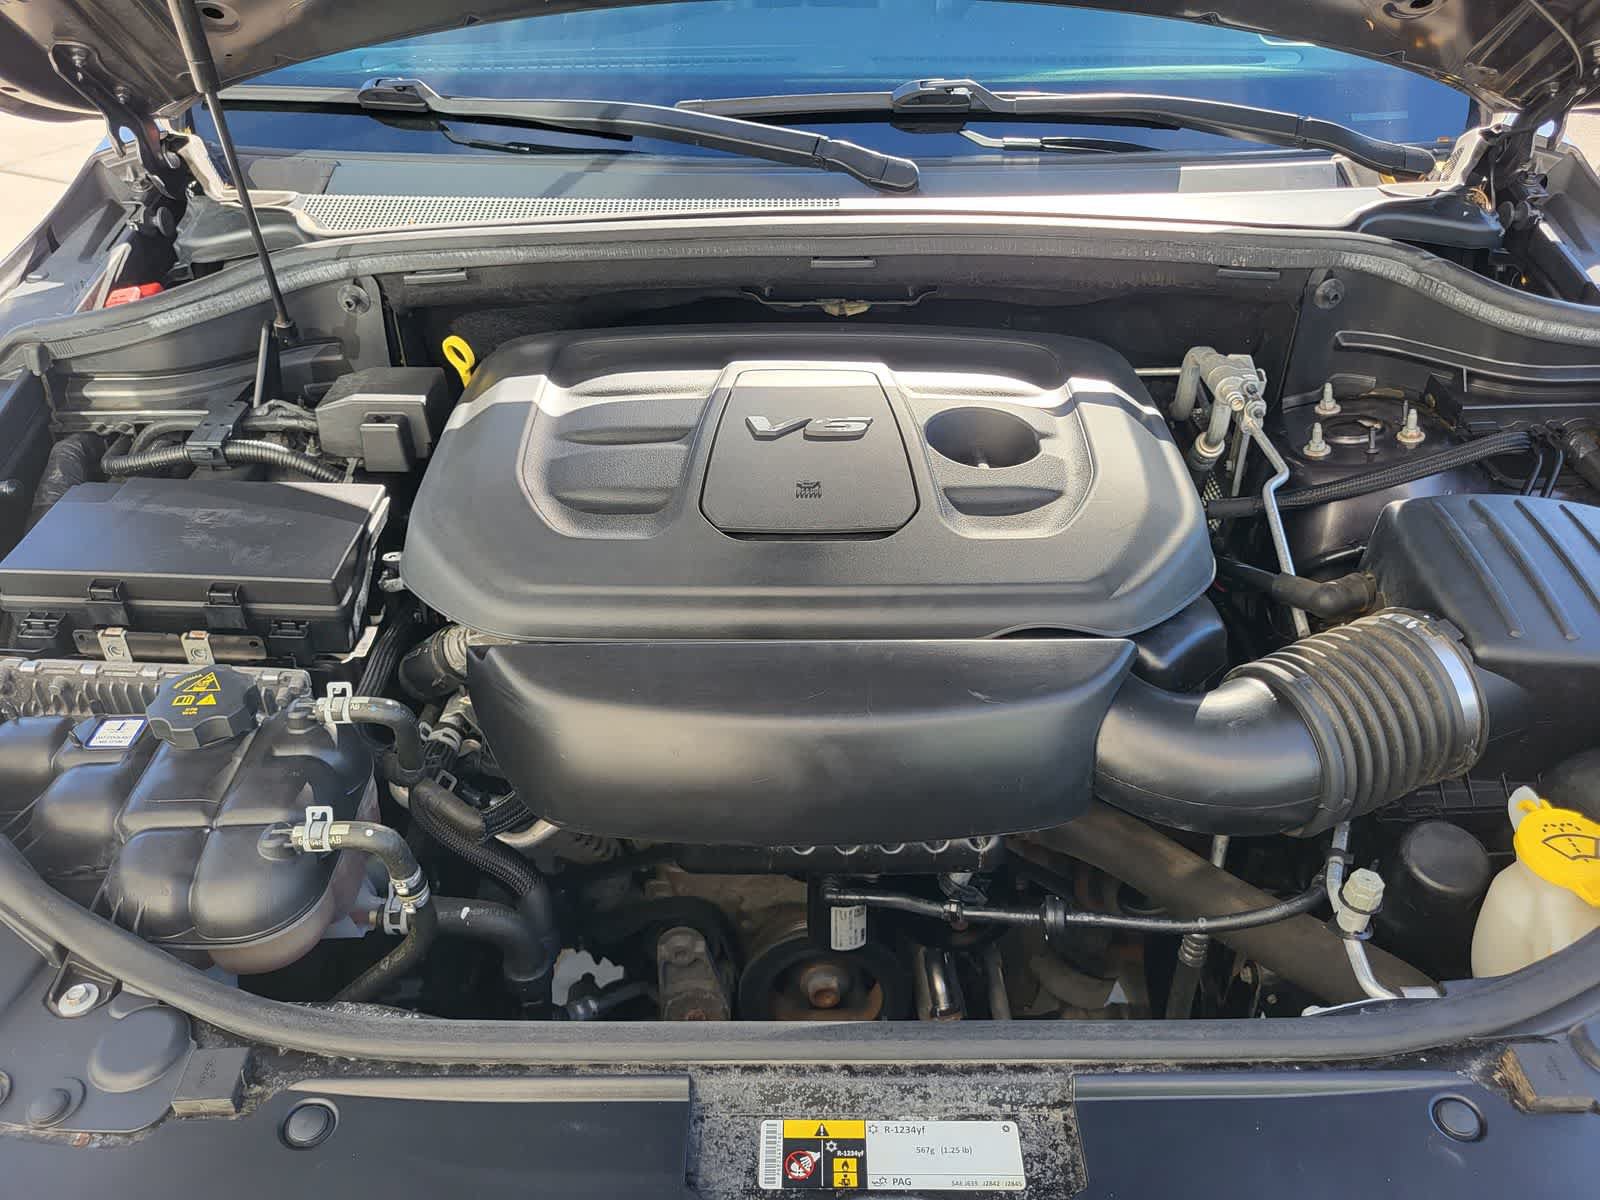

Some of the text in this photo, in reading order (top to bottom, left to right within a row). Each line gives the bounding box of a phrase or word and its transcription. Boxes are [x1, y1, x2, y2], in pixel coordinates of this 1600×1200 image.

[745, 416, 873, 441] V6
[884, 1125, 926, 1135] R-1234yf
[915, 1146, 936, 1155] 567g
[892, 1177, 912, 1186] PAG
